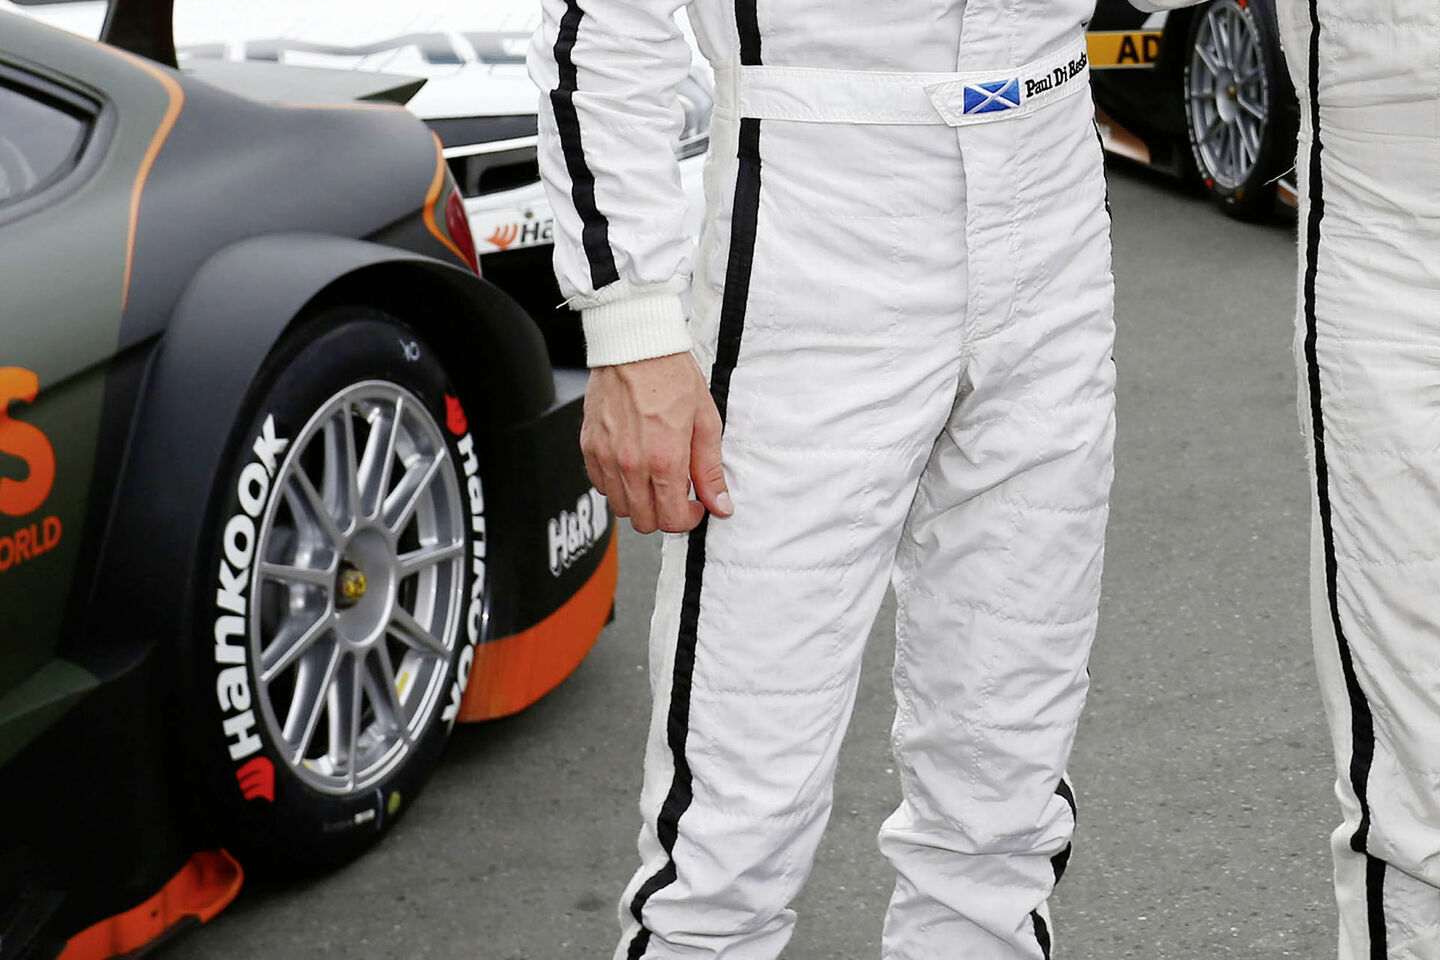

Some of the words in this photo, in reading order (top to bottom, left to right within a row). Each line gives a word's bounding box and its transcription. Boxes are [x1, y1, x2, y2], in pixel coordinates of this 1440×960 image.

[1117, 35, 1161, 65] AD
[1025, 73, 1053, 98] Paul
[1054, 65, 1068, 88] Di
[0, 515, 63, 572] ORLD
